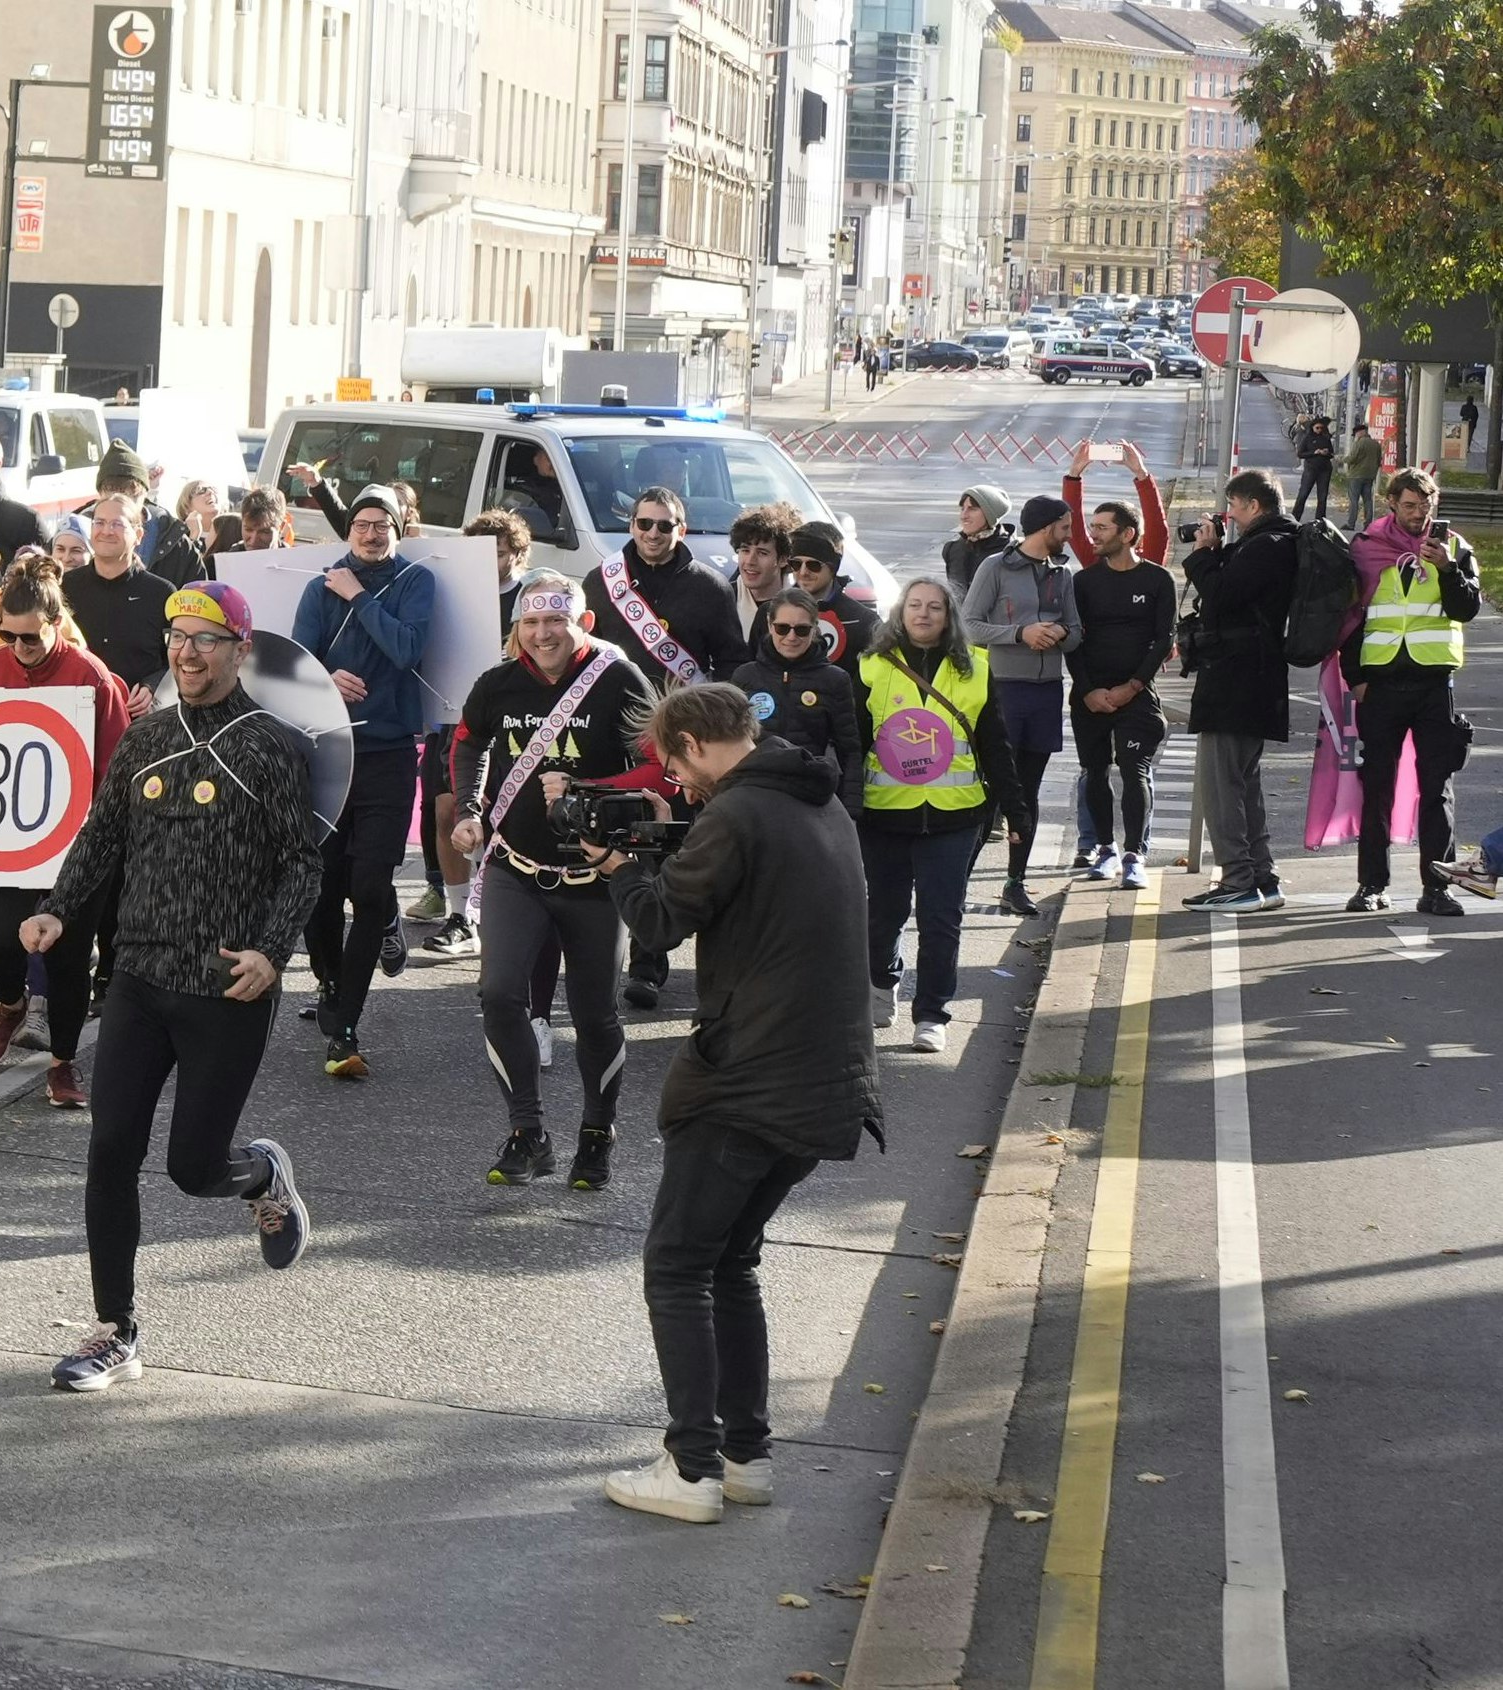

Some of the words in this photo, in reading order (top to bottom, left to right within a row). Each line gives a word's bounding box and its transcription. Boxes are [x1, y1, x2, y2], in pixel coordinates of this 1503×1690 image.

[130, 94, 154, 102] Diesel
[109, 129, 131, 137] Super
[1092, 365, 1122, 373] POLIZEI
[902, 757, 934, 769] GÜRTEL
[903, 766, 928, 777] LIEBE
